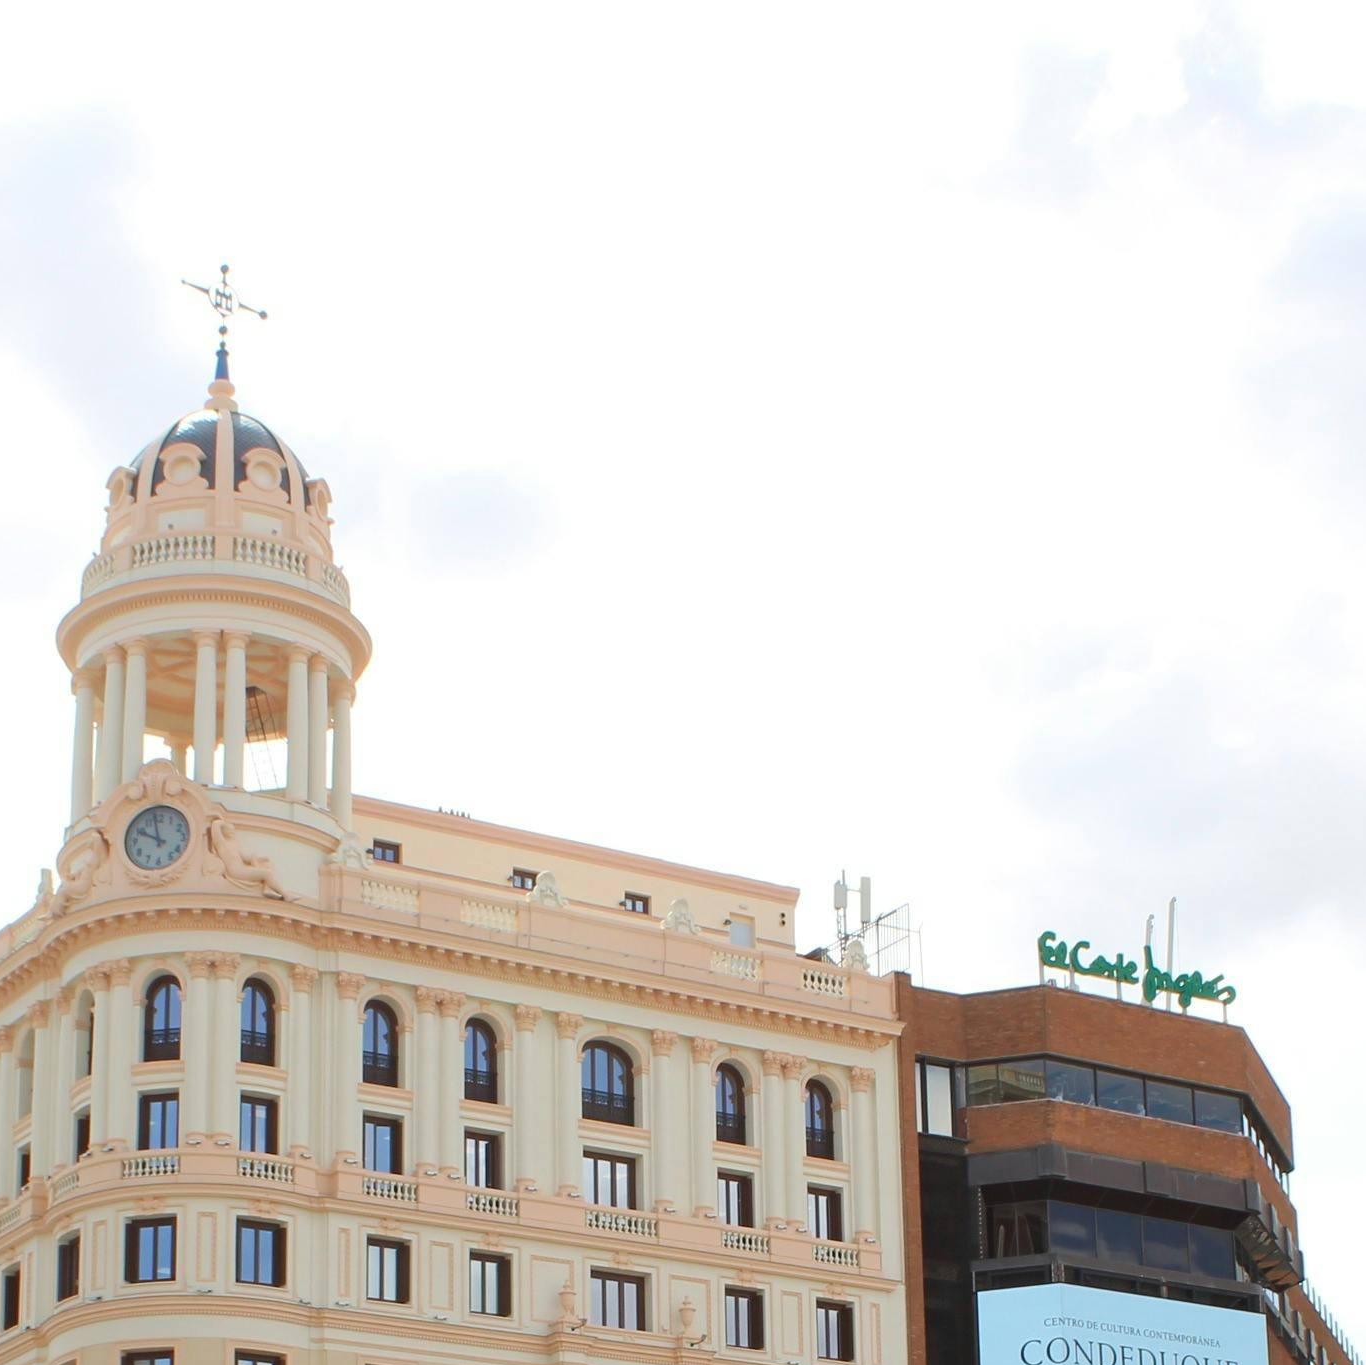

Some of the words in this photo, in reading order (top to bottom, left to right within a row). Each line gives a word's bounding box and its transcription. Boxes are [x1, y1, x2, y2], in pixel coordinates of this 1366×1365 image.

[1038, 931, 1069, 968] El
[1070, 940, 1139, 984] Corte
[1043, 1317, 1085, 1328] CENTRO
[1086, 1320, 1099, 1330] DE
[1100, 1322, 1141, 1337] CULTURA
[1143, 1328, 1221, 1348] CONTEMPORÁNEA
